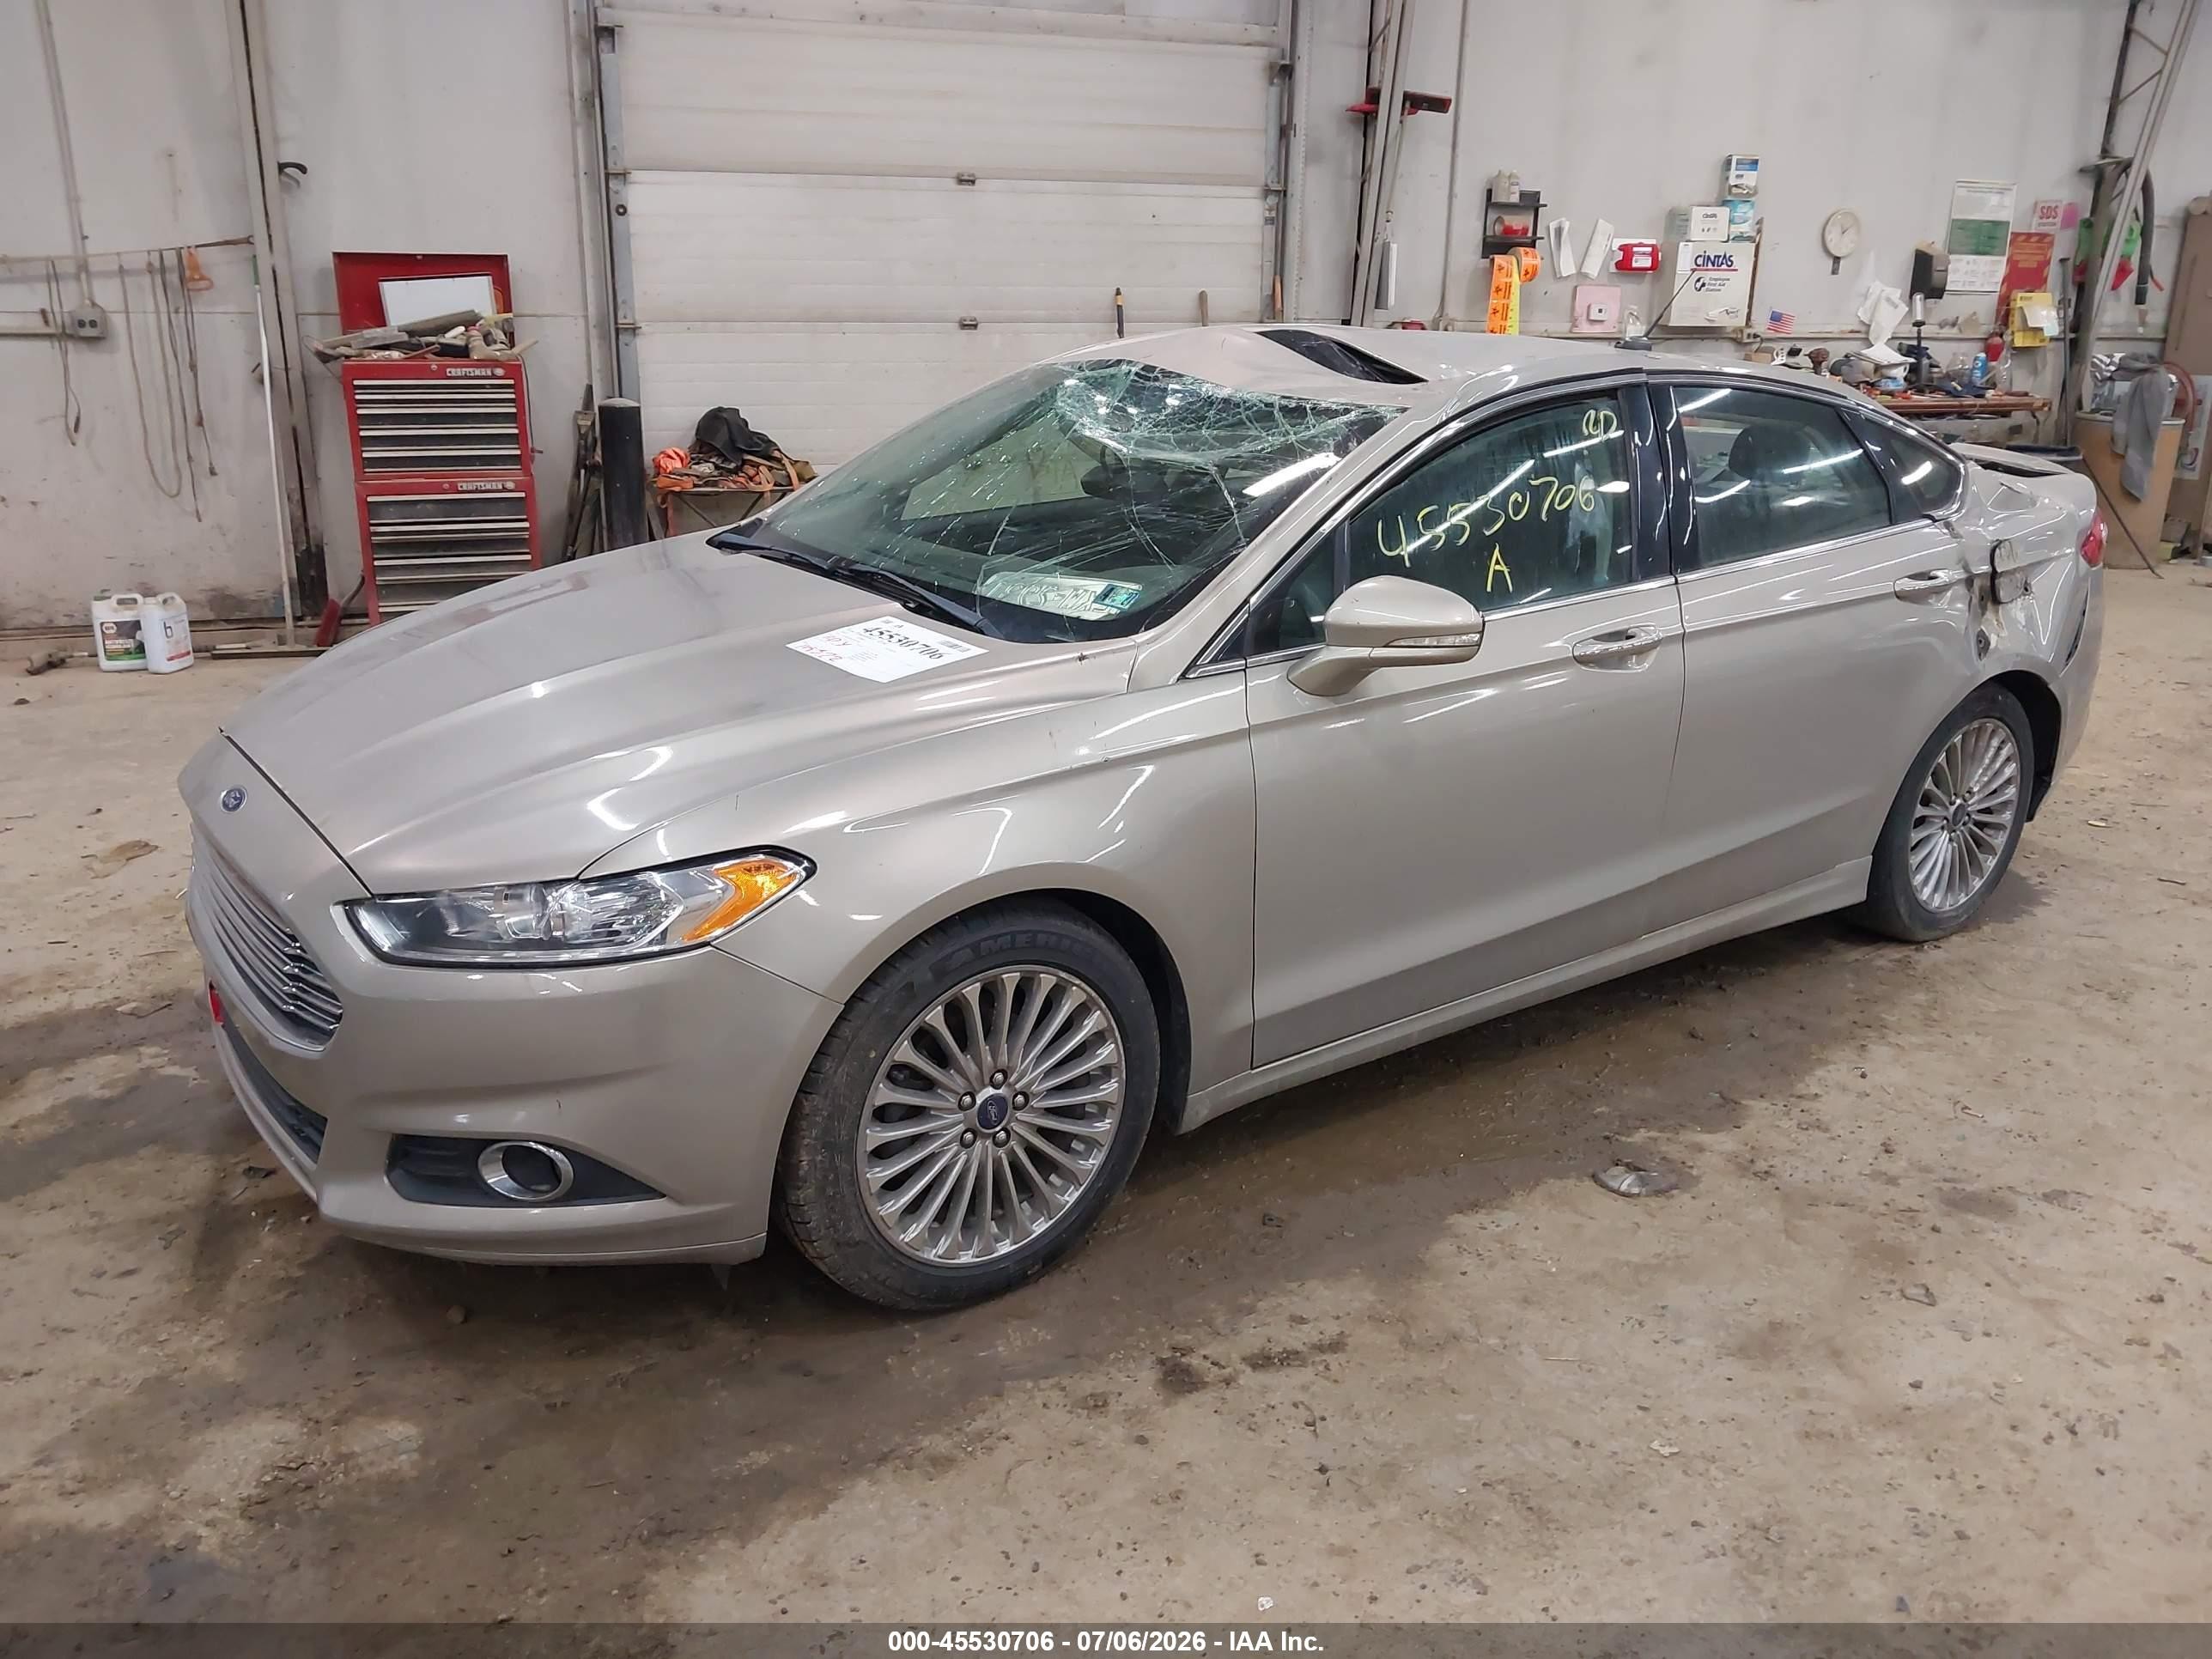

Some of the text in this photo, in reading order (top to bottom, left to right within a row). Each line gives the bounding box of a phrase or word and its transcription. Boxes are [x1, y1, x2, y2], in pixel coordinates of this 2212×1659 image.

[2039, 205, 2059, 220] SDS
[1694, 250, 1734, 268] CINTAS
[1377, 475, 1595, 568] 45530706
[1486, 543, 1513, 592] A
[862, 626, 944, 659] 45530706
